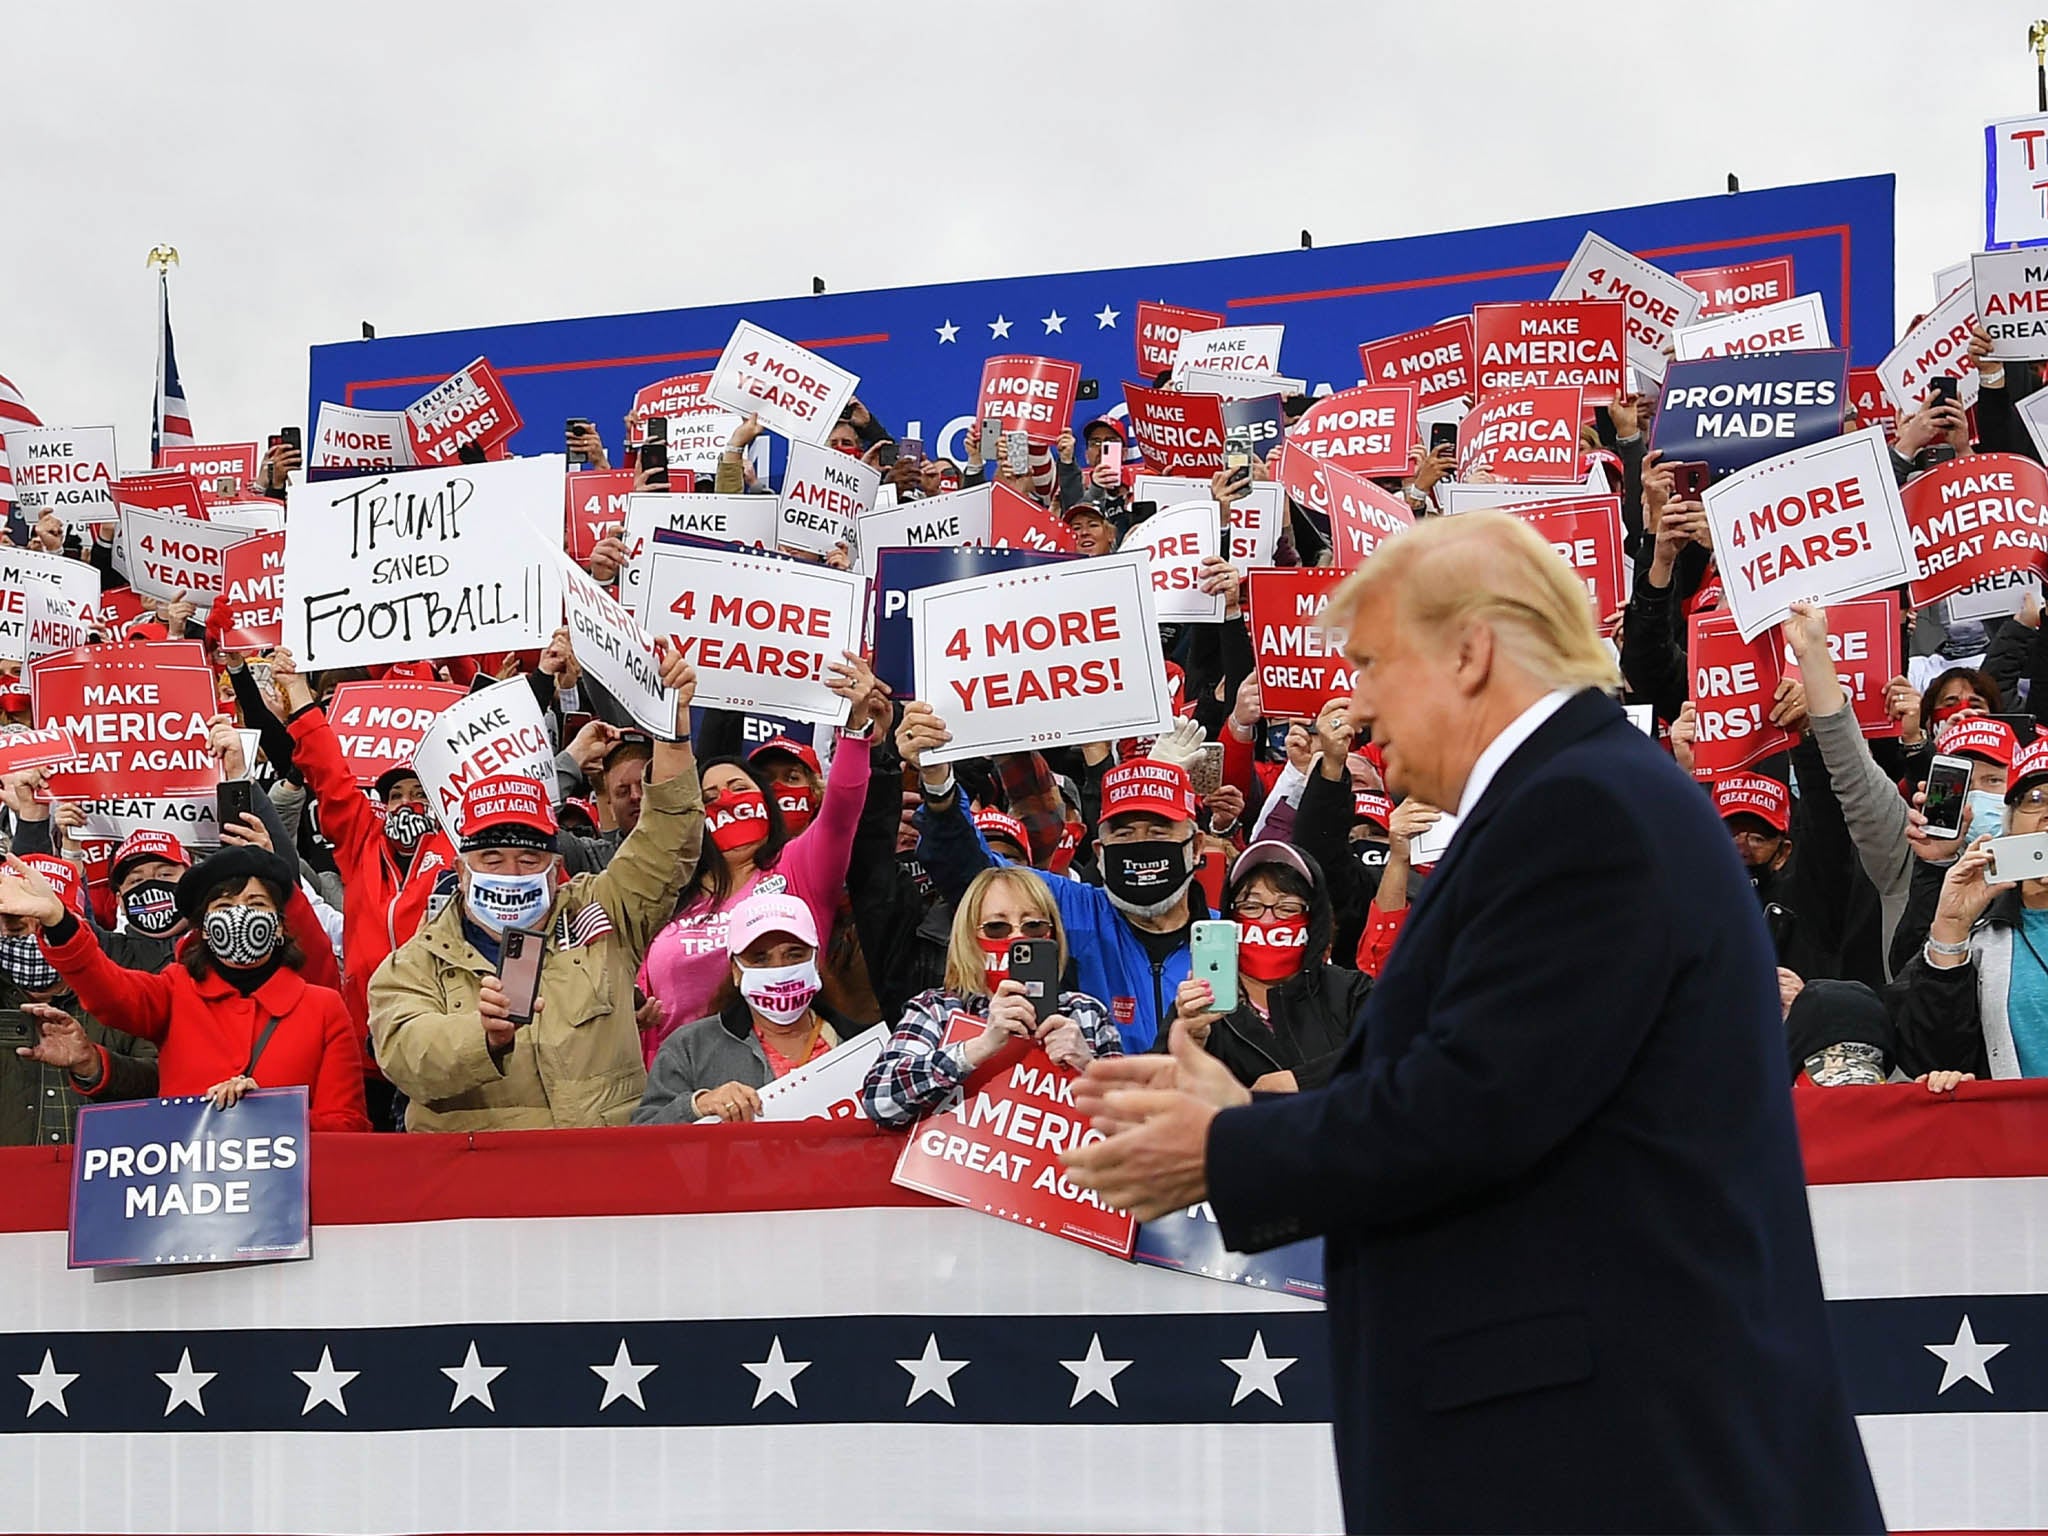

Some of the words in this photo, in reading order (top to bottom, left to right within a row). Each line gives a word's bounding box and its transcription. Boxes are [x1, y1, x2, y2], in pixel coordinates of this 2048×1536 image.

[1587, 268, 1606, 286] 4
[1607, 276, 1680, 328] MORE
[1715, 280, 1779, 306] MORE
[1143, 323, 1152, 339] 4
[1520, 318, 1579, 336] MAKE
[1724, 324, 1805, 355] MORE
[1143, 345, 1178, 365] YEAR
[1207, 340, 1246, 353] MAKE
[1481, 339, 1619, 366] AMERICA
[1177, 355, 1270, 376] AMERICA
[1382, 361, 1397, 379] 4
[1400, 343, 1463, 376] MORE
[743, 351, 759, 366] 4
[762, 357, 831, 401] MORE
[987, 379, 995, 394] 4
[999, 377, 1060, 400] MORE
[1419, 367, 1467, 396] ARS!
[1482, 371, 1549, 389] GREAT
[1554, 369, 1619, 386] AGAIN
[1902, 369, 1915, 388] 4
[414, 377, 464, 416] TRUMP
[421, 387, 464, 417] PENCE
[662, 383, 700, 397] MAKE
[736, 371, 818, 421] YEARS!
[1665, 381, 1836, 410] PROMISES
[1858, 392, 1873, 410] 4
[416, 426, 431, 444] 4
[431, 386, 491, 435] MORE
[637, 395, 709, 416] AMERIC
[984, 401, 1055, 422] YEARS!
[1145, 403, 1185, 422] MAKE
[1481, 401, 1534, 427] MAKE
[675, 424, 715, 436] MAKE
[1135, 418, 1222, 448] AMERICA
[1294, 420, 1310, 436] 4
[1317, 407, 1396, 434] MORE
[1695, 413, 1796, 438] MADE
[324, 428, 332, 446] 4
[334, 434, 392, 450] MORE
[426, 408, 500, 463] YEARS!
[666, 436, 726, 451] MERIC
[1460, 420, 1572, 465] AMERICA
[28, 442, 73, 459] MAKE
[1171, 449, 1224, 467] AGAIN
[1503, 447, 1572, 464] AGAIN
[15, 461, 111, 486] AMERICA
[190, 459, 244, 476] MORE
[824, 466, 860, 493] MAKE
[20, 492, 49, 506] GREAT
[54, 488, 114, 504] AGAIN
[789, 481, 862, 519] AMERIC
[1941, 473, 2014, 503] MAKE
[584, 495, 602, 514] 4
[1342, 495, 1356, 518] 4
[1358, 501, 1409, 535] MOR
[1730, 519, 1746, 548] 4
[1750, 477, 1865, 541] MORE
[331, 476, 475, 559] TRUMP
[670, 514, 728, 532] MAKE
[783, 508, 838, 538] GREAT
[907, 516, 960, 545] MAKE
[141, 536, 154, 553] 4
[162, 541, 222, 565] MOR
[1740, 521, 1872, 593] YEARS!
[1918, 535, 1984, 580] GREAT
[372, 554, 449, 584] SAVED
[231, 607, 283, 630] GREA
[304, 563, 543, 661] FOOTBALL!!
[670, 591, 696, 620] 4
[709, 594, 831, 639] MORE
[945, 628, 971, 661] 4
[985, 606, 1120, 657] MORE
[1260, 624, 1349, 658] AMER
[573, 609, 621, 661] GREAT
[624, 648, 665, 702] AGAIN
[670, 634, 823, 682] YEARS!
[950, 658, 1123, 712] YEARS!
[1263, 665, 1325, 690] GREAT
[1697, 662, 1759, 699] ORE
[83, 684, 160, 706] MAKE
[725, 697, 754, 707] 2020
[44, 712, 211, 743] AMERICA
[341, 706, 361, 726] 4
[366, 707, 436, 731] MOR
[446, 707, 510, 754] MAKE
[743, 716, 786, 742] EPT
[1960, 721, 2006, 736] AMERICA
[0, 728, 61, 748] GAIN
[1031, 732, 1061, 742] 2020
[1967, 734, 2000, 747] AGAIN
[46, 752, 119, 775] GREAT
[130, 750, 215, 772] AGAIN
[437, 723, 549, 814] AMERICA
[1105, 768, 1131, 786] MAKE
[1131, 766, 1180, 784] AMERICA
[468, 783, 496, 800] MAKE
[497, 781, 541, 800] AMERICA
[1110, 786, 1140, 802] GREAT
[1142, 783, 1175, 801] AGAIN
[1355, 793, 1391, 808] MERICA
[1717, 778, 1743, 793] MAKE
[1743, 779, 1784, 801] AMERICA
[1720, 792, 1750, 806] GREAT
[1749, 793, 1778, 811] AGAIN
[82, 801, 155, 818] GREAT
[163, 803, 215, 822] AGA
[474, 800, 505, 817] GREAT
[507, 799, 537, 813] AGAIN
[1357, 804, 1387, 816] AGAIN
[981, 812, 1021, 833] AMERICA
[1122, 859, 1169, 871] Trump
[473, 884, 543, 906] TRUMP
[754, 877, 784, 895] TRUMP
[138, 911, 173, 929] 2020
[763, 980, 805, 994] WOMEN
[749, 989, 817, 1012] TRUMP
[1009, 1063, 1074, 1106] MAK
[934, 1085, 1106, 1156] AMERIC
[83, 1135, 297, 1181] PROMISES
[920, 1129, 1031, 1184] GREAT
[125, 1180, 250, 1218] MADE
